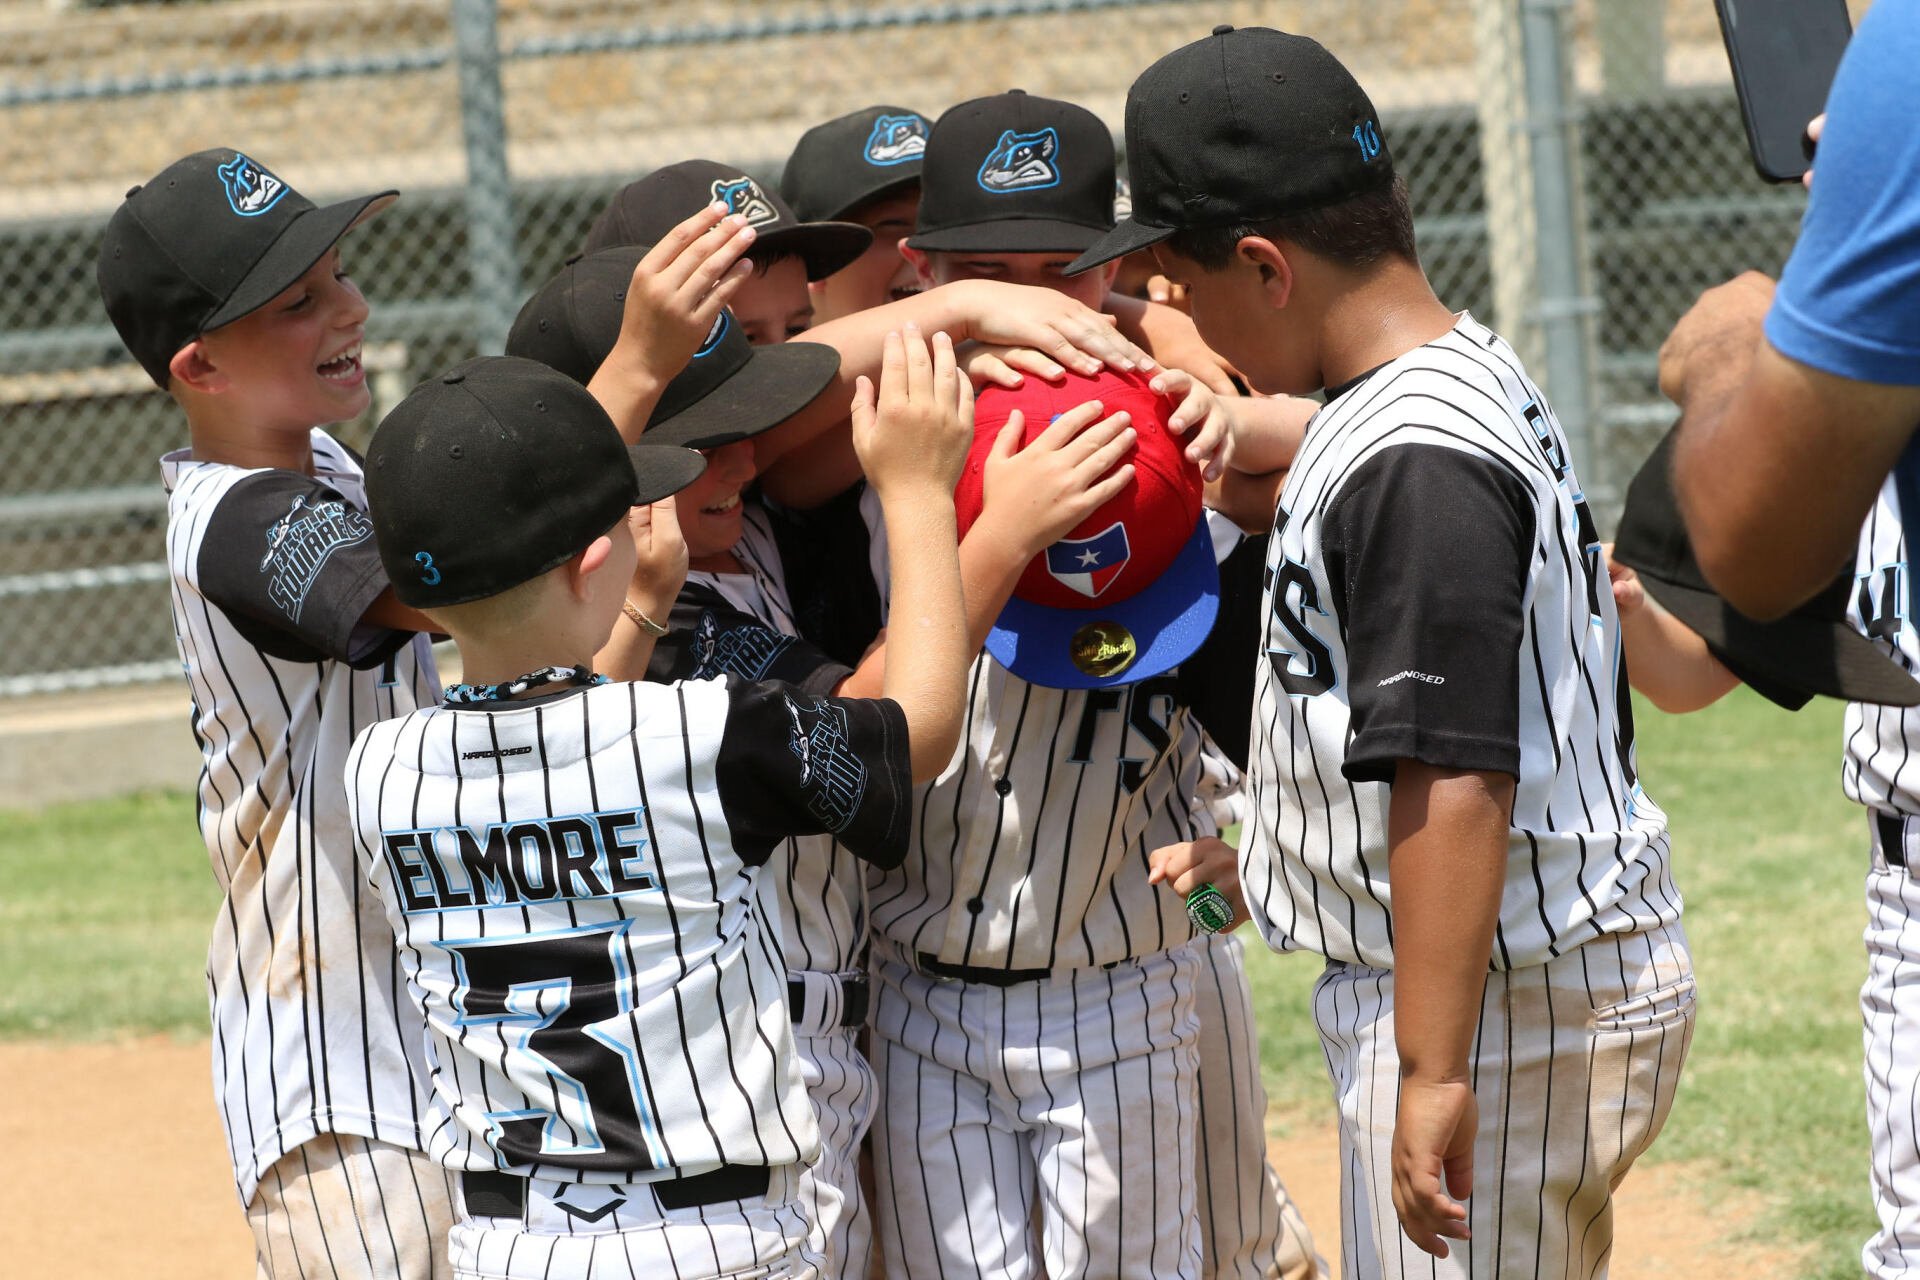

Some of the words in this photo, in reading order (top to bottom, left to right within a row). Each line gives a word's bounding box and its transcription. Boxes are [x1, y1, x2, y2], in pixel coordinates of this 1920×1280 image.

[1352, 120, 1379, 161] 10
[268, 512, 373, 621] SQUIRRES
[414, 551, 441, 586] 3
[1377, 670, 1445, 688] HARDNOSED
[381, 806, 666, 915] ELMORE
[432, 918, 670, 1172] 3
